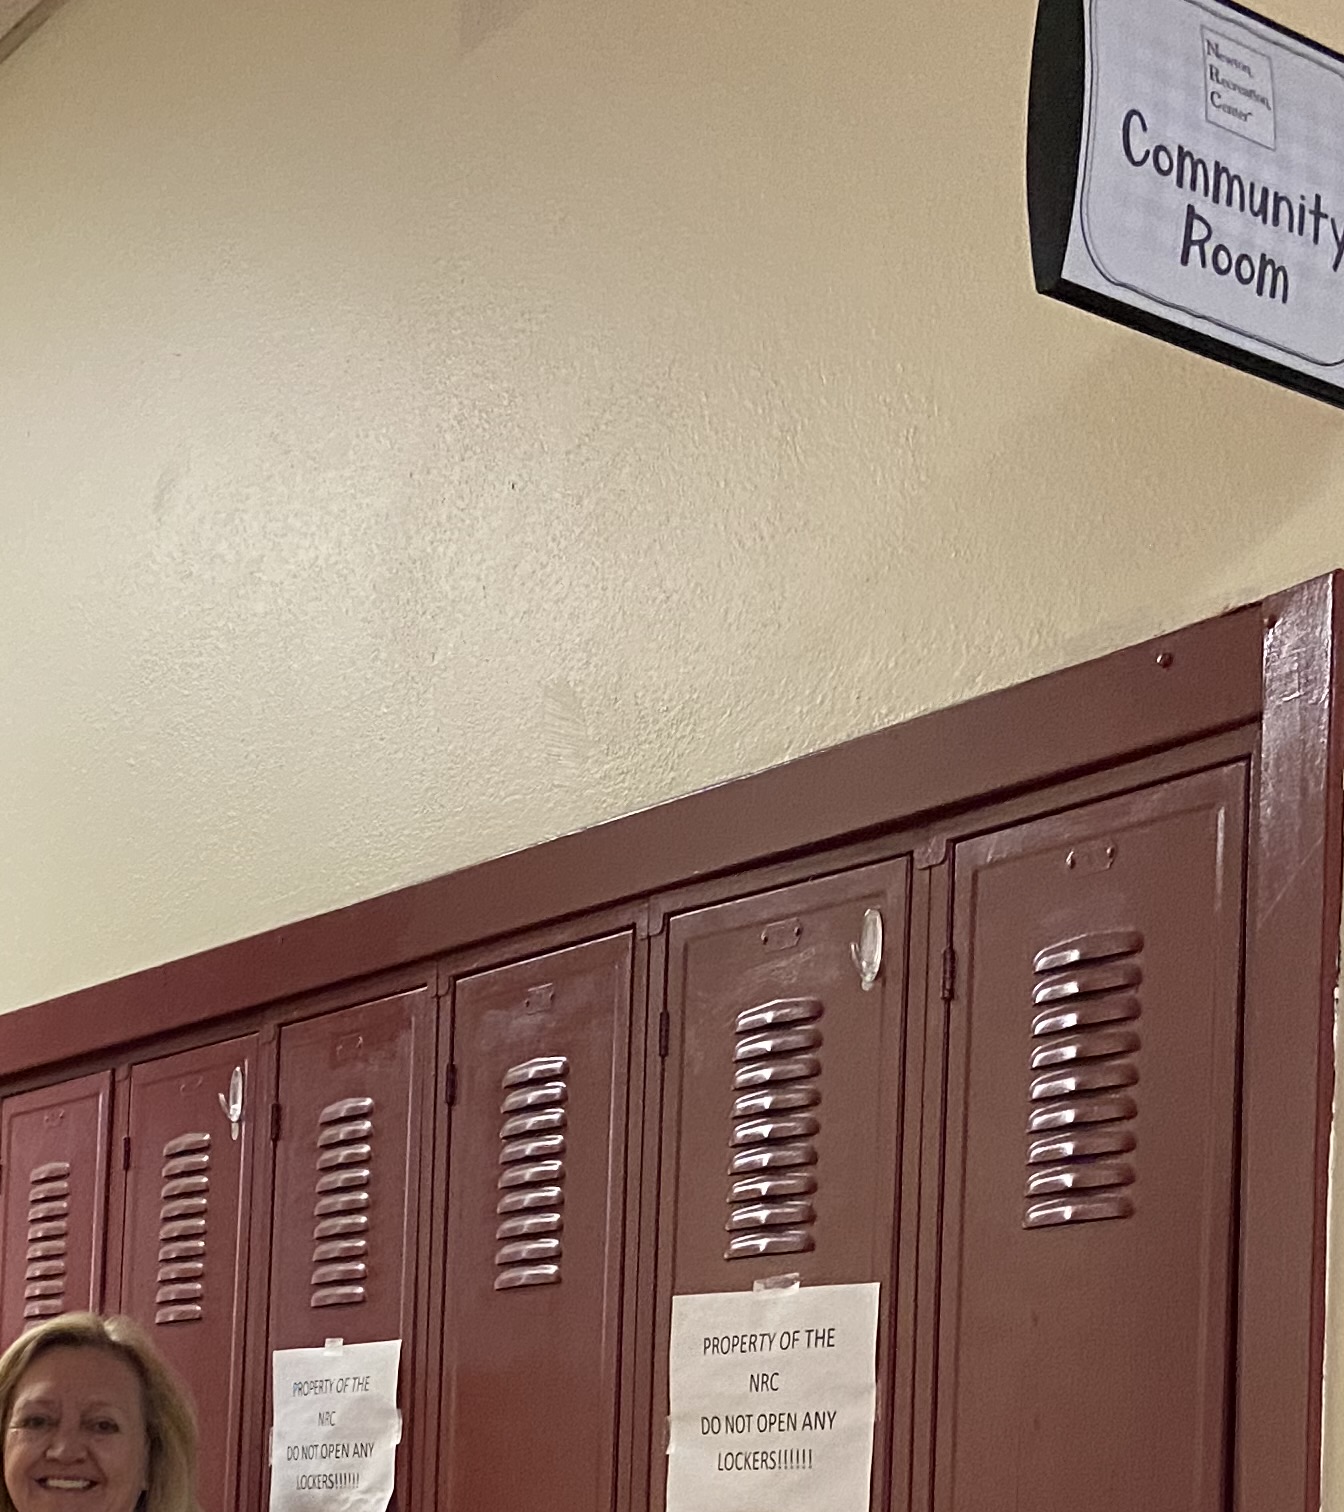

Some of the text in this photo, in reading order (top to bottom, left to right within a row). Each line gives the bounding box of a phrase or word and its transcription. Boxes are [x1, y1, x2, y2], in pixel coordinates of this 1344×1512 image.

[1179, 204, 1289, 304] Room
[703, 1327, 836, 1356] PROPERTY OF THE
[292, 1375, 371, 1398] PROPERTY OF THE
[749, 1372, 780, 1393] NRC
[318, 1410, 337, 1427] NRC
[701, 1410, 837, 1436] DO NOT OPEN ANY
[287, 1442, 375, 1462] DO NOT OPEN ANY
[717, 1448, 813, 1471] LOCKERS!!!!!!
